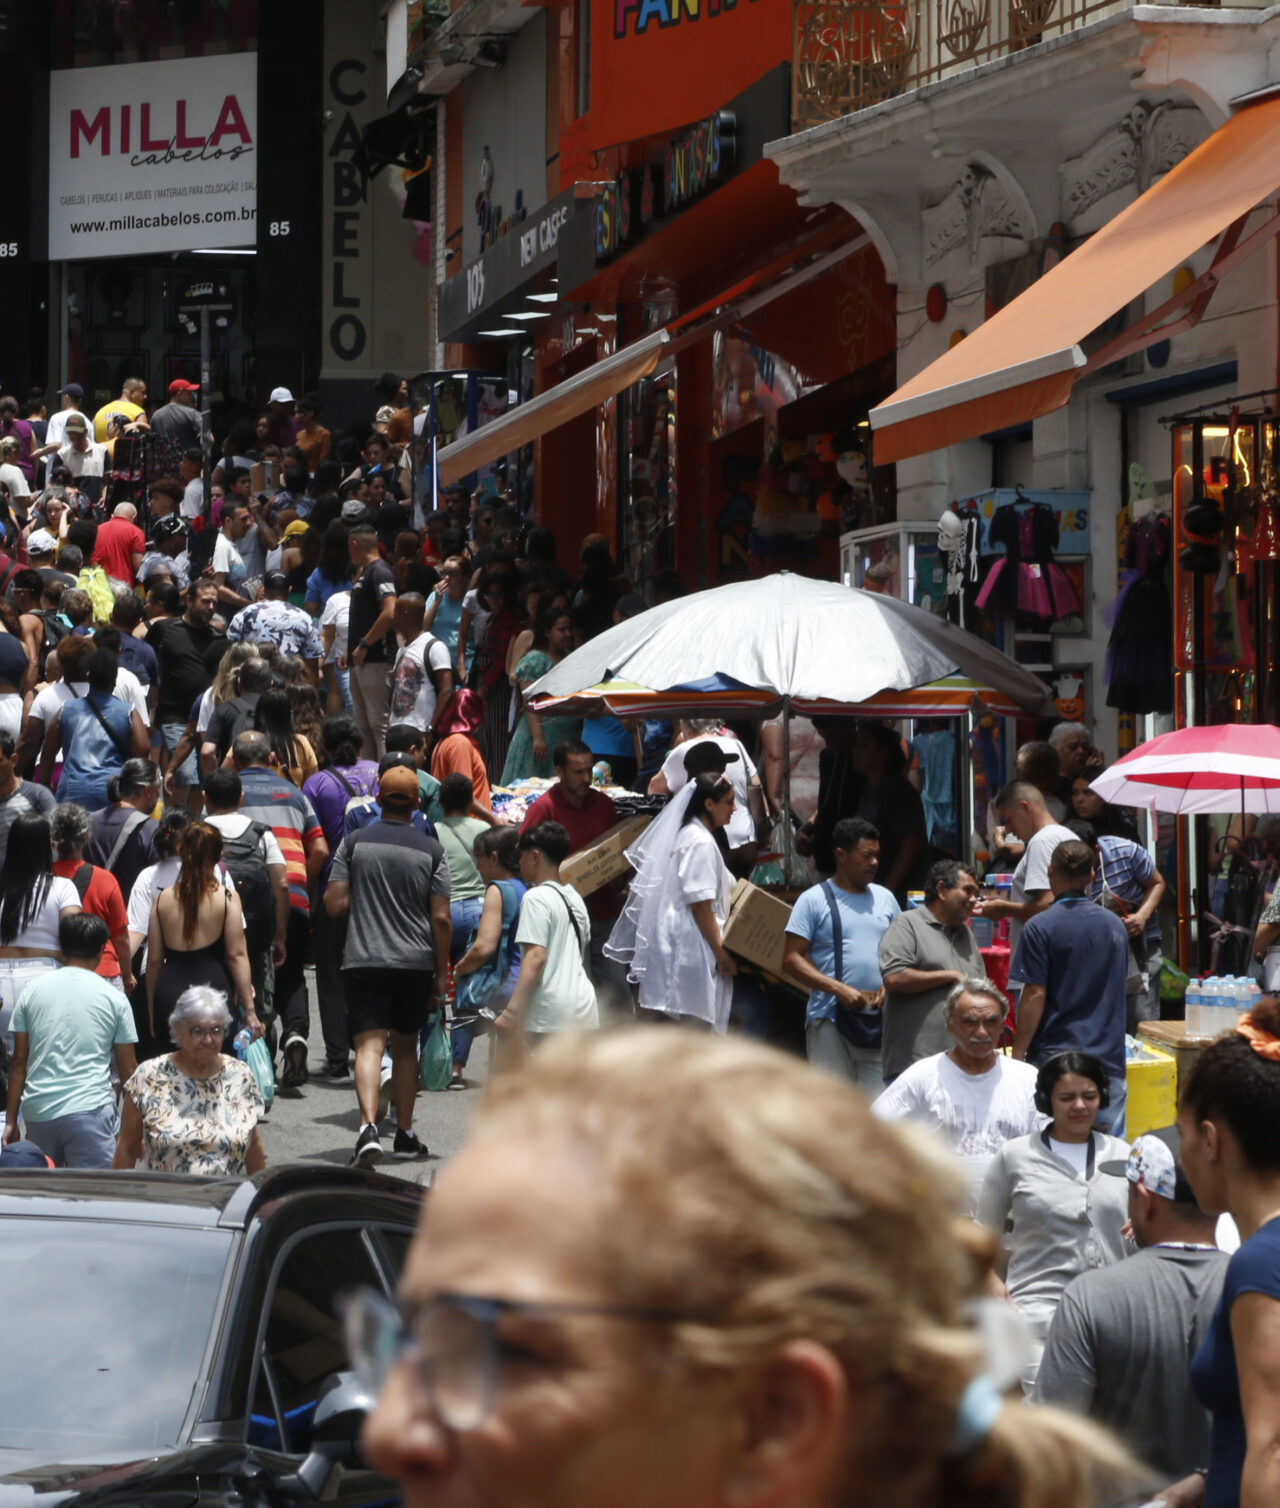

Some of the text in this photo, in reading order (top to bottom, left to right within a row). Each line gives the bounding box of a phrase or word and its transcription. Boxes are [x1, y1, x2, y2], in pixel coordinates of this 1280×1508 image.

[70, 95, 252, 159] MILLA
[130, 134, 254, 167] cabelos
[60, 195, 86, 207] CABELOS
[91, 193, 118, 205] PERUCAS
[124, 190, 152, 201] APLIQUES
[157, 187, 187, 199] MATERIAIS
[188, 185, 204, 196] PARA
[204, 181, 239, 195] COLOCAÇÃO
[70, 206, 257, 234] www.millacabelos.com.br
[328, 58, 368, 362] CABELO
[270, 221, 290, 237] 85
